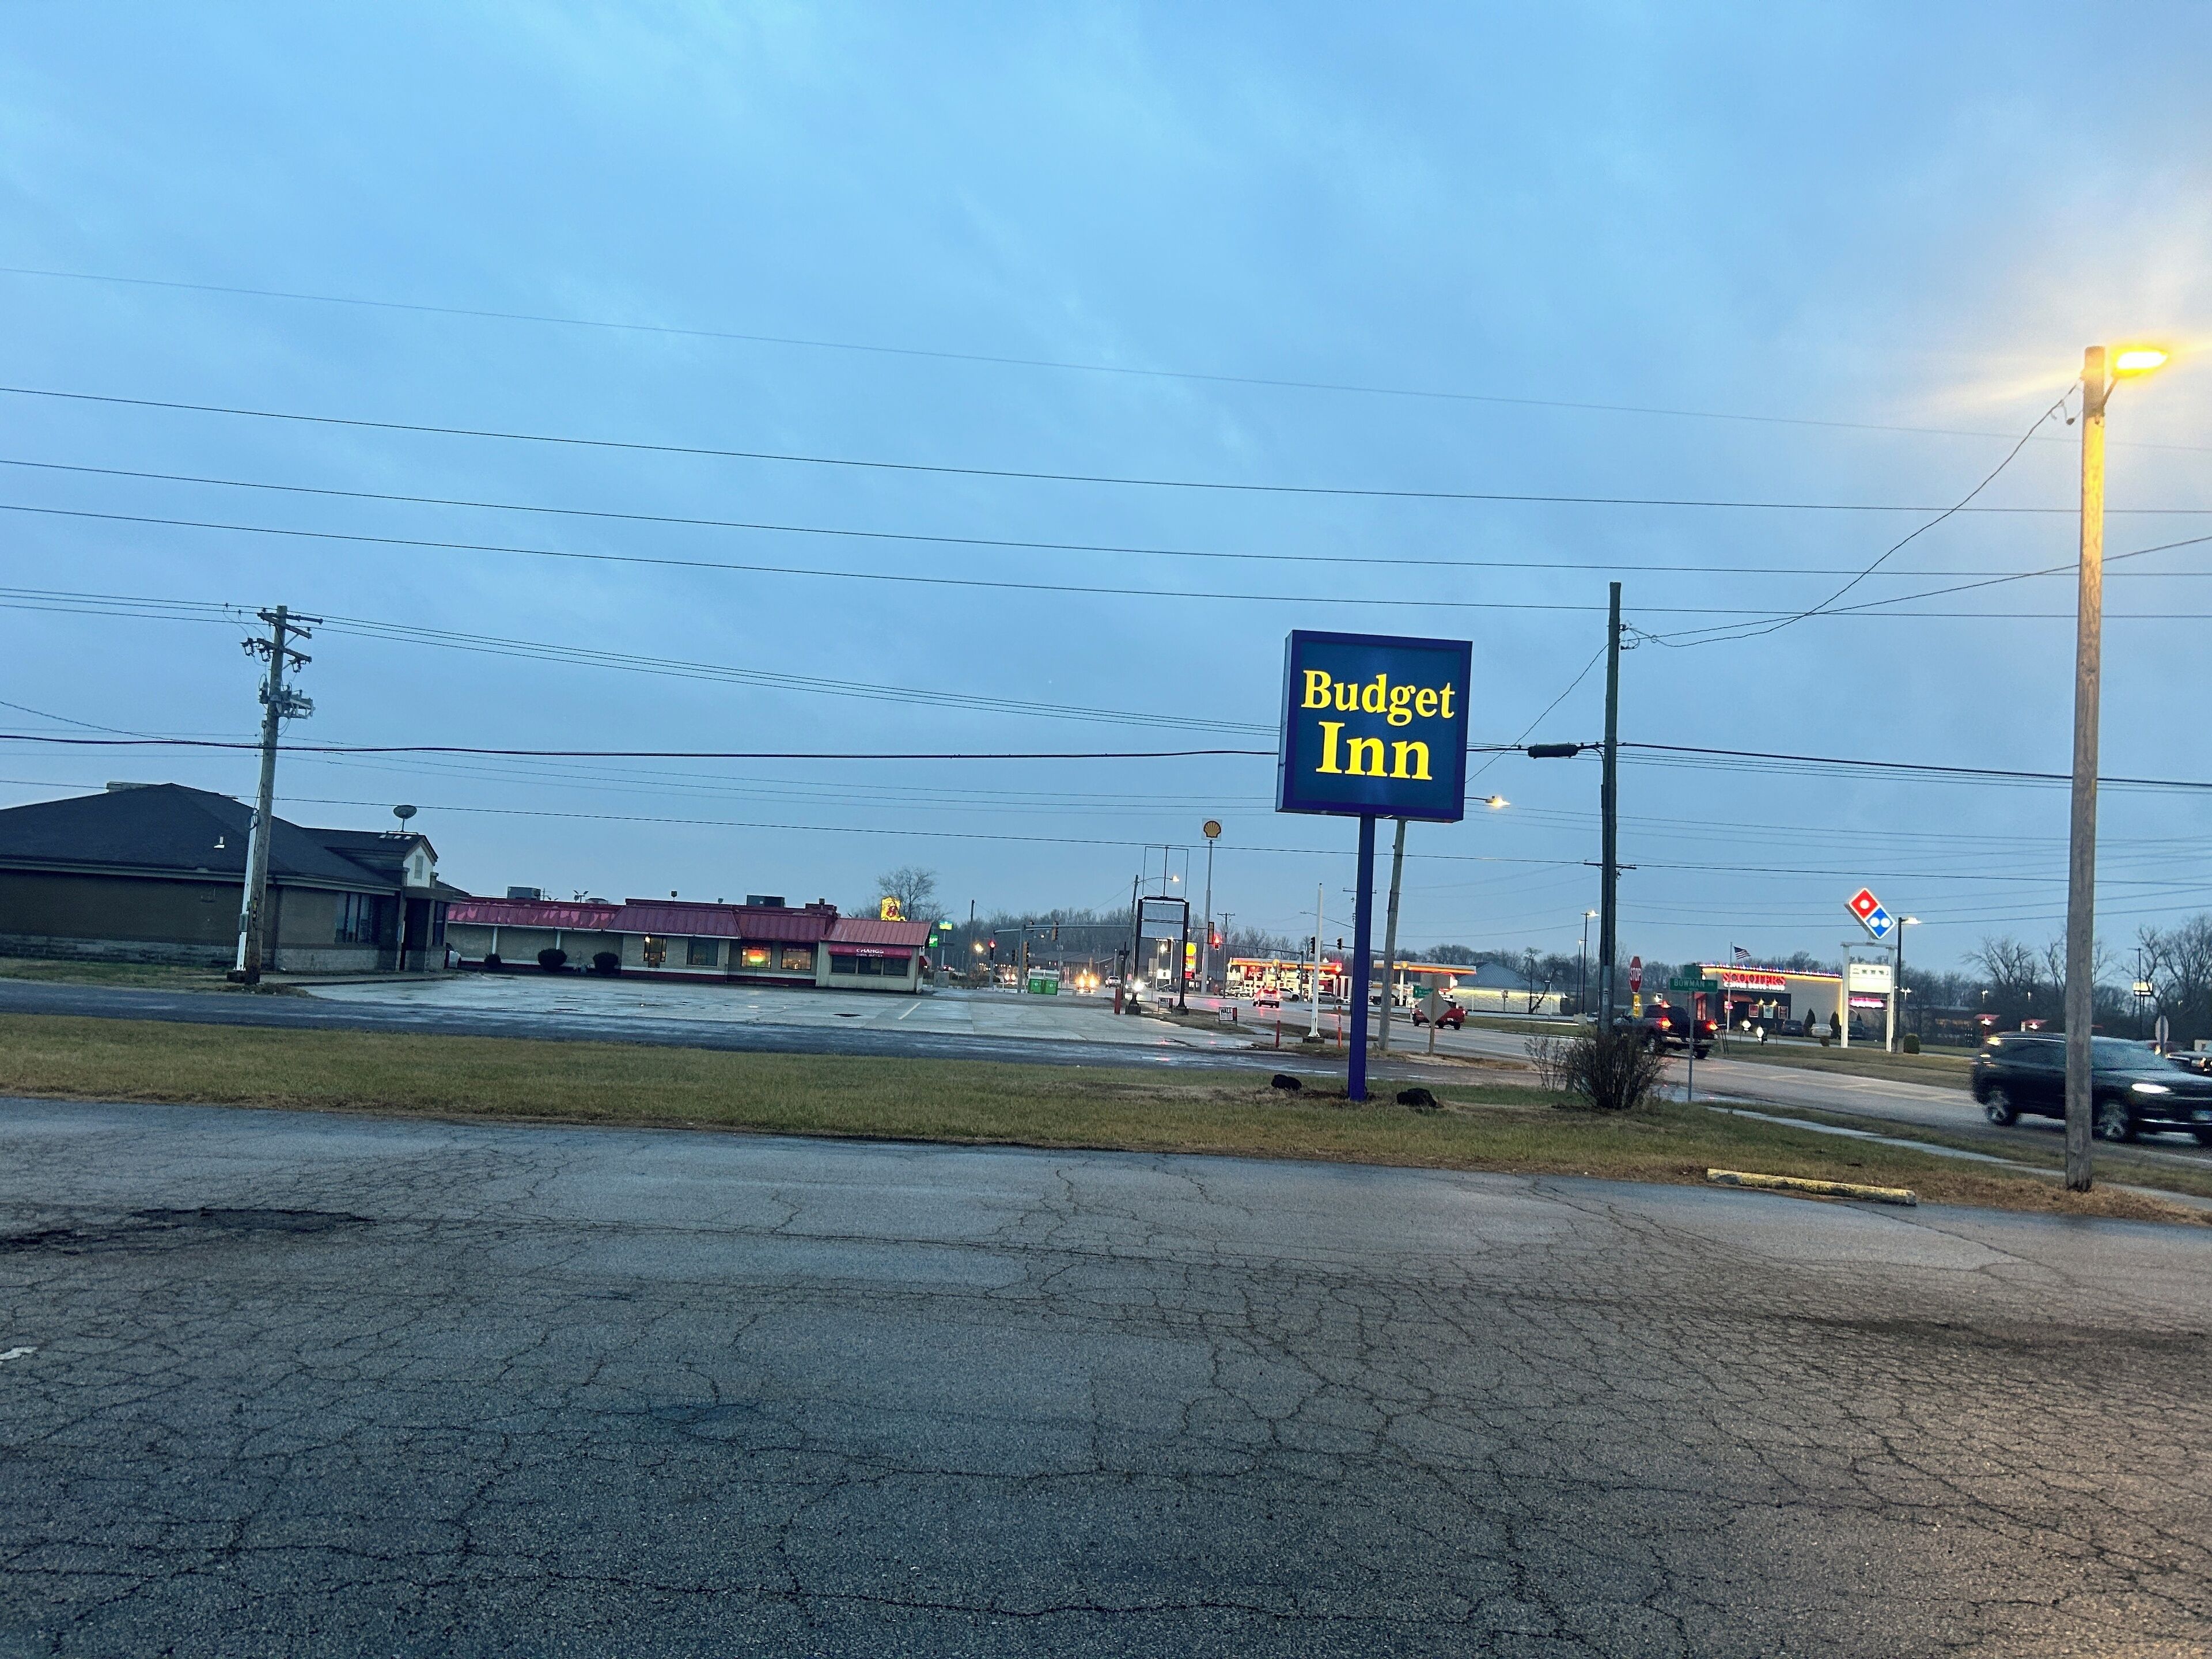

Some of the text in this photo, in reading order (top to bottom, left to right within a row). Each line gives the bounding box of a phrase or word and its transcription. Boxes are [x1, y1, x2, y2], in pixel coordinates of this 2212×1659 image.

[1301, 669, 1455, 726] Budget
[1316, 721, 1433, 781] Inn
[1630, 967, 1641, 982] STOP
[1722, 972, 1786, 986] SCOOTER'S
[1673, 978, 1705, 988] BOWMAN
